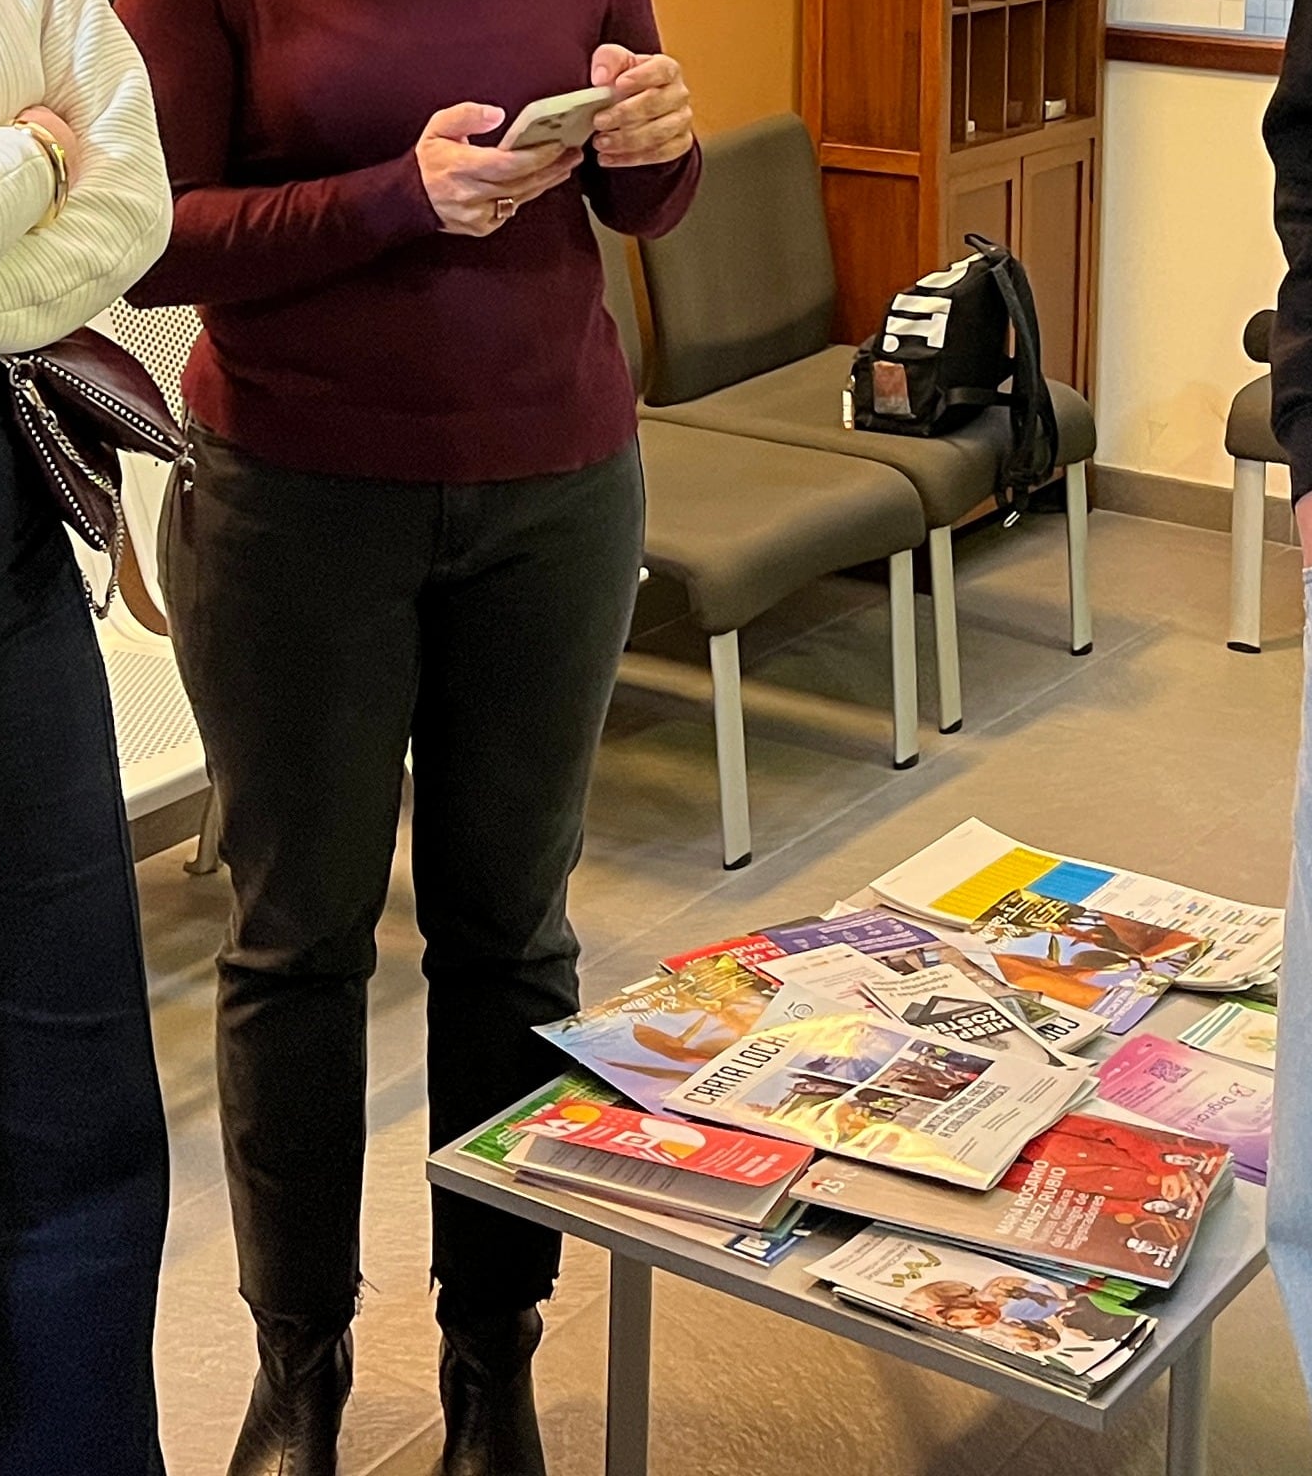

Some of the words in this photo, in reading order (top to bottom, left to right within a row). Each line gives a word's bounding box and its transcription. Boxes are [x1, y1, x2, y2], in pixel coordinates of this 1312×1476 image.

[683, 1065, 753, 1105] CARTA
[1014, 1159, 1049, 1208] ROSARIO
[1038, 1166, 1066, 1203] RUBIO
[1073, 1192, 1089, 1205] de
